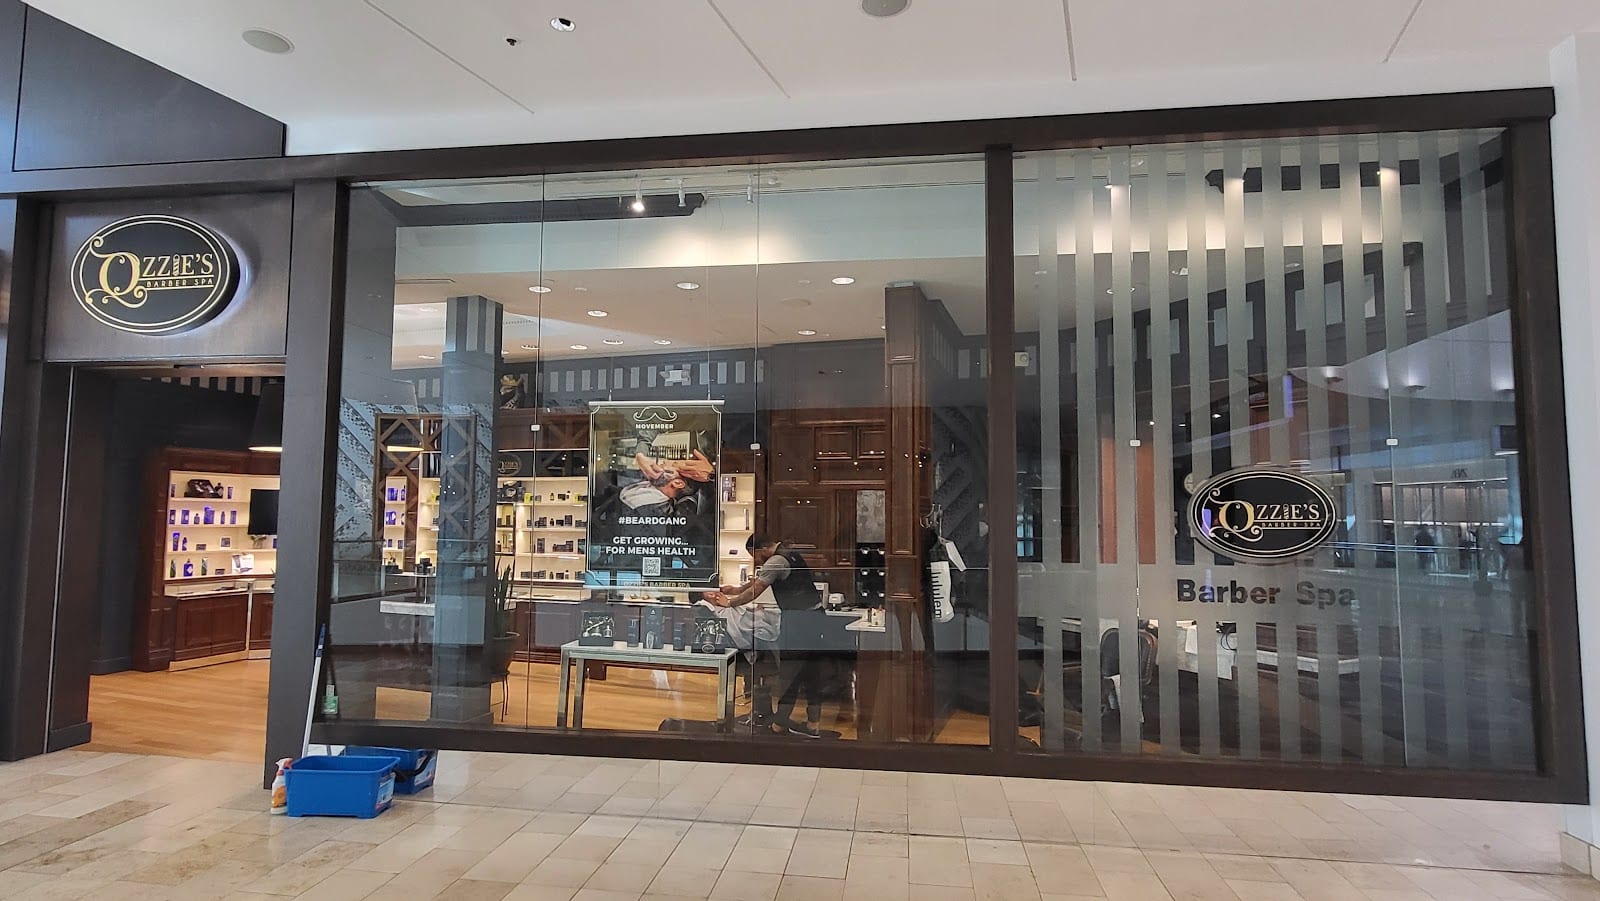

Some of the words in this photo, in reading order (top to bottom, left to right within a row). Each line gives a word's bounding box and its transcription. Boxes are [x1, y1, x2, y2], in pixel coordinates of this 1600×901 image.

[146, 279, 187, 288] BARBER
[194, 278, 213, 286] SPA
[618, 516, 687, 525] #BEARDGANG
[613, 536, 633, 545] GET
[633, 537, 689, 546] GROWING...
[605, 546, 626, 555] FOR
[627, 546, 656, 555] MENS
[657, 547, 696, 556] HEALTH
[1177, 579, 1281, 604] Barber
[1296, 581, 1356, 610] Spa
